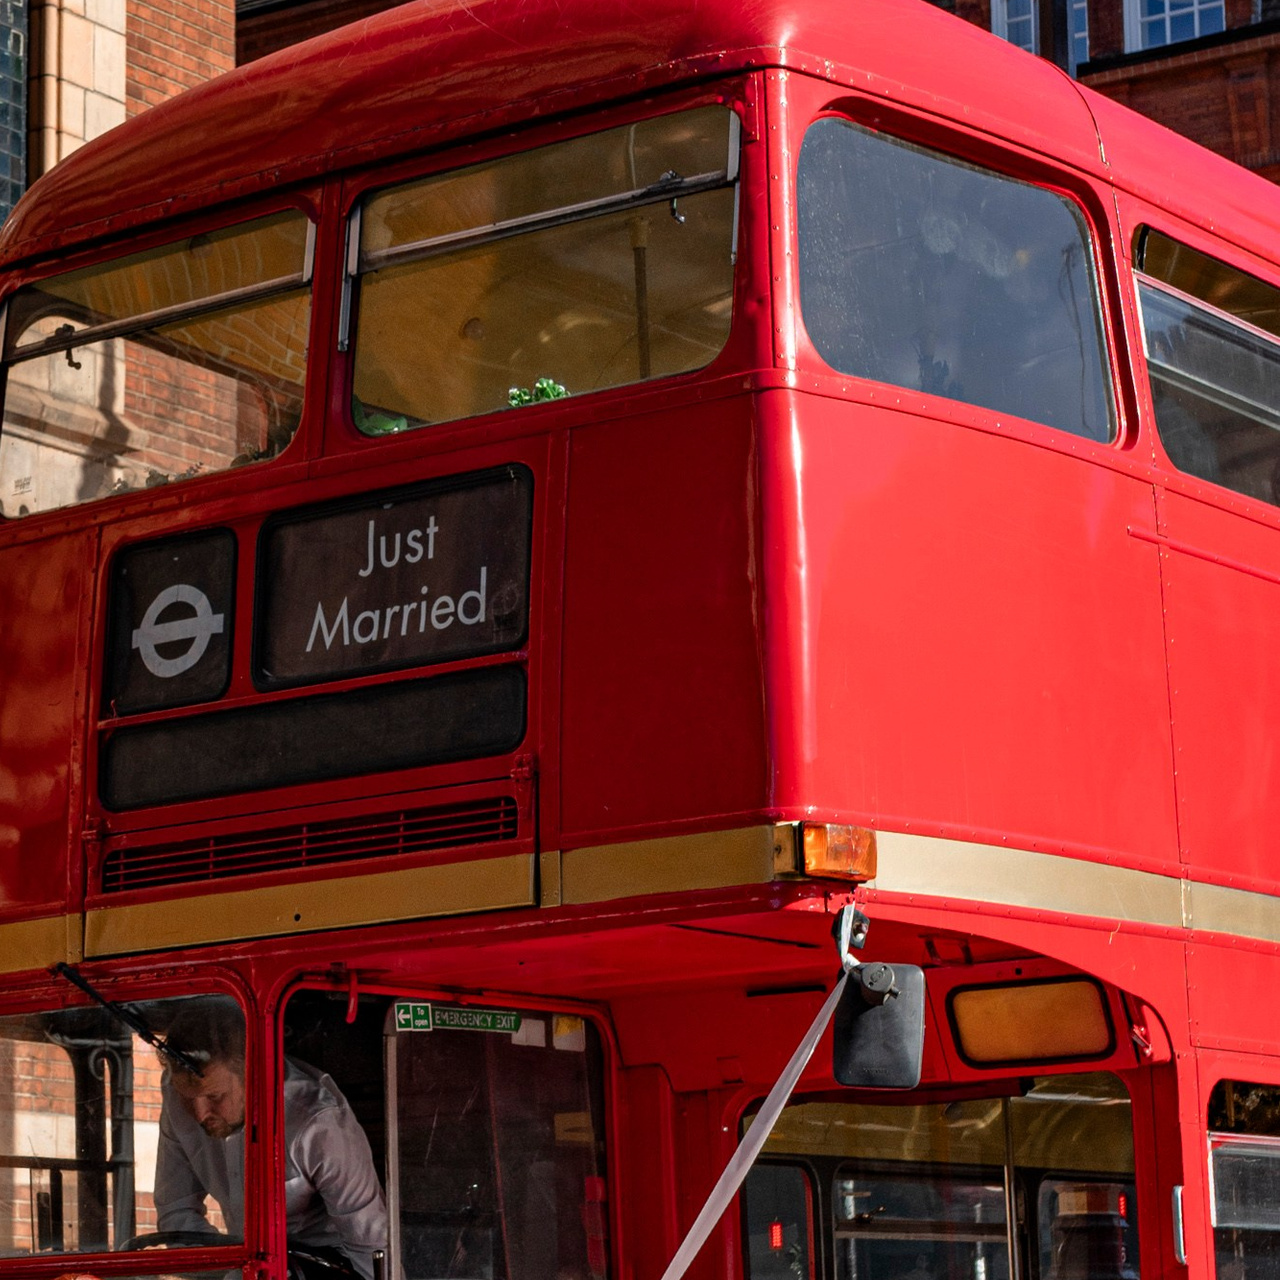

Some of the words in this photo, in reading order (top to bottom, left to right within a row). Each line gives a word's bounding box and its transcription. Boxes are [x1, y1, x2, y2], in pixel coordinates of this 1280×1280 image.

[358, 515, 439, 578] Just
[305, 566, 488, 653] Married
[416, 1007, 425, 1016] To
[435, 1010, 492, 1027] EMERGENCY
[496, 1015, 516, 1029] EXIT
[414, 1018, 429, 1027] open
